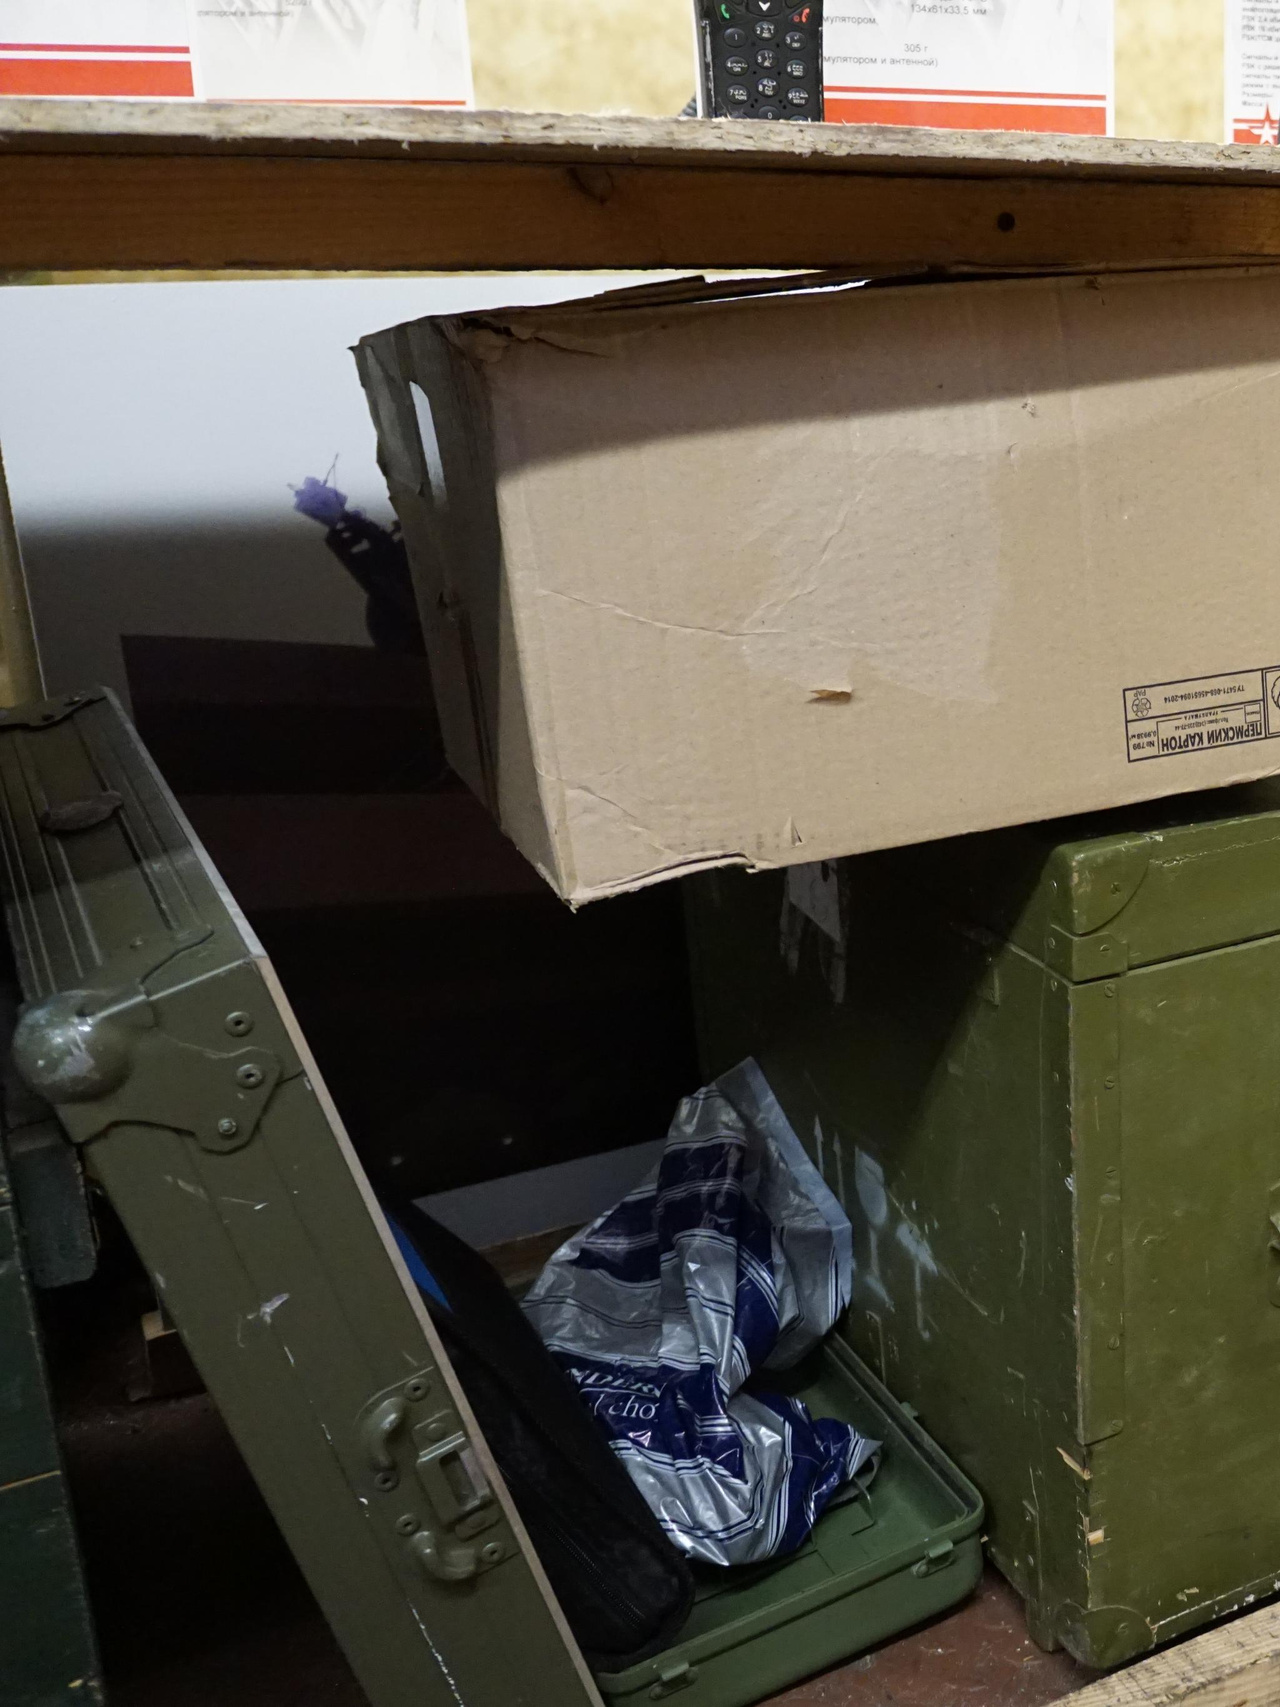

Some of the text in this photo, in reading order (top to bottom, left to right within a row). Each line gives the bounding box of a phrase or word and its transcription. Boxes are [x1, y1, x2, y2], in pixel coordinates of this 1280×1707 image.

[904, 43, 922, 53] 305
[889, 57, 939, 68] антенной)
[1161, 721, 1263, 752] ПЕРМСКИЙ КАРТОН
